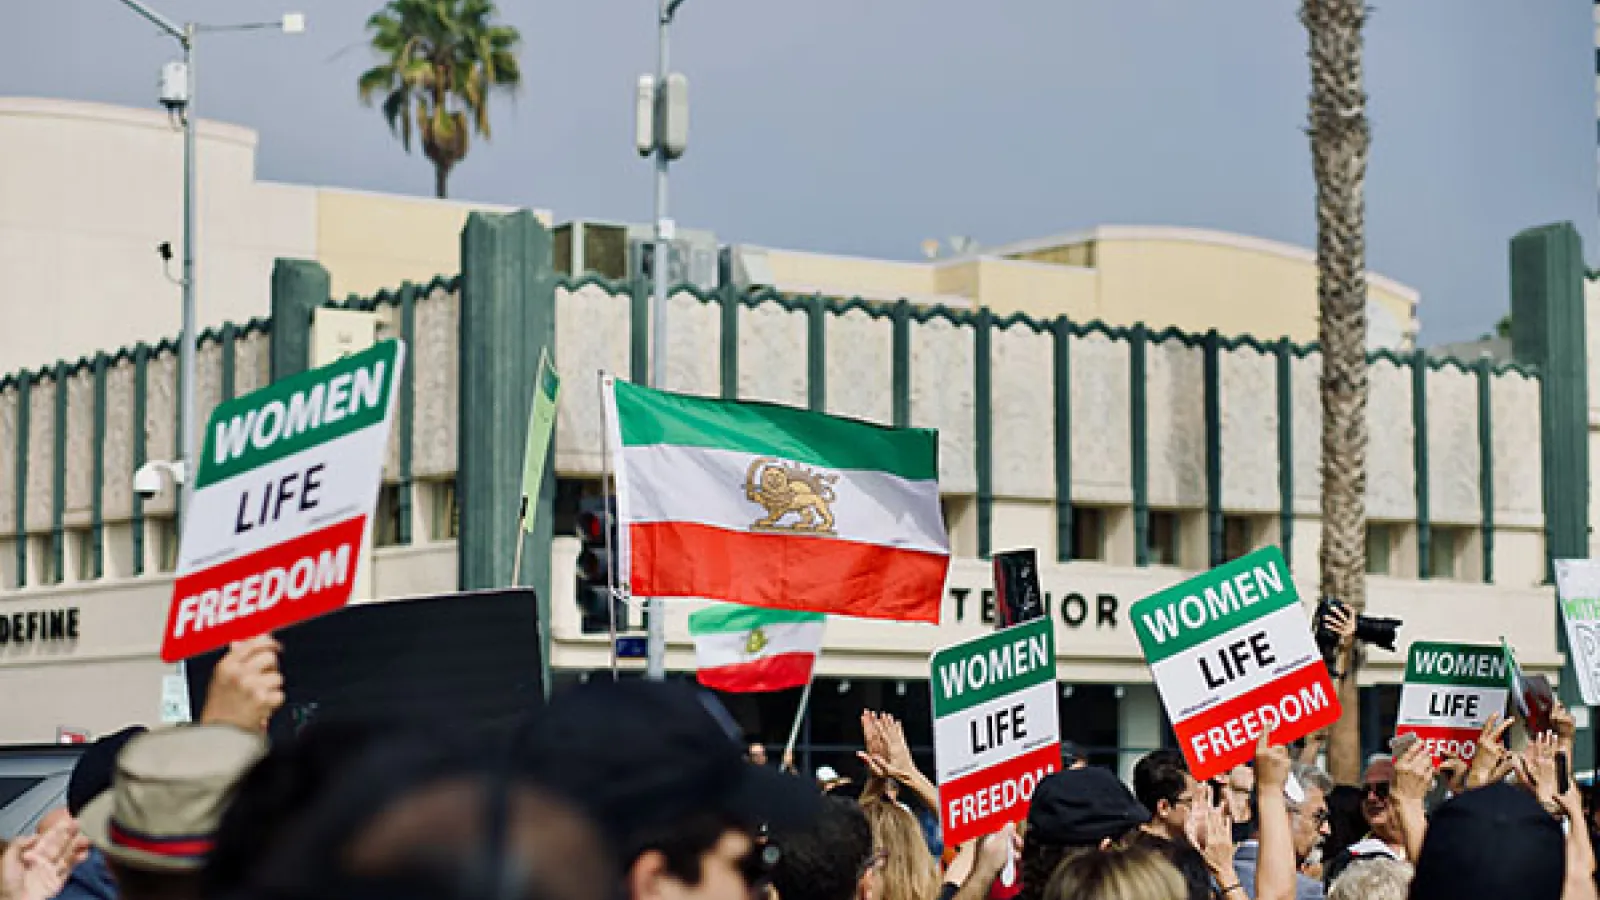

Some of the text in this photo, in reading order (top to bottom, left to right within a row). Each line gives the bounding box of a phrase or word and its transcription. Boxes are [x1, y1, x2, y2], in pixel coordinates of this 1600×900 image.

[215, 360, 386, 464] WOMEN
[234, 462, 326, 535] LIFE
[173, 543, 350, 638] FREEDOM
[1141, 561, 1284, 643] WOMEN
[940, 633, 1049, 699] WOMEN
[1198, 631, 1276, 690] LIFE
[1415, 650, 1505, 679] WOMEN
[970, 703, 1027, 754] LIFE
[1190, 681, 1329, 763] FREEDOM
[1429, 691, 1479, 717] LIFE
[948, 764, 1054, 829] FREEDO
